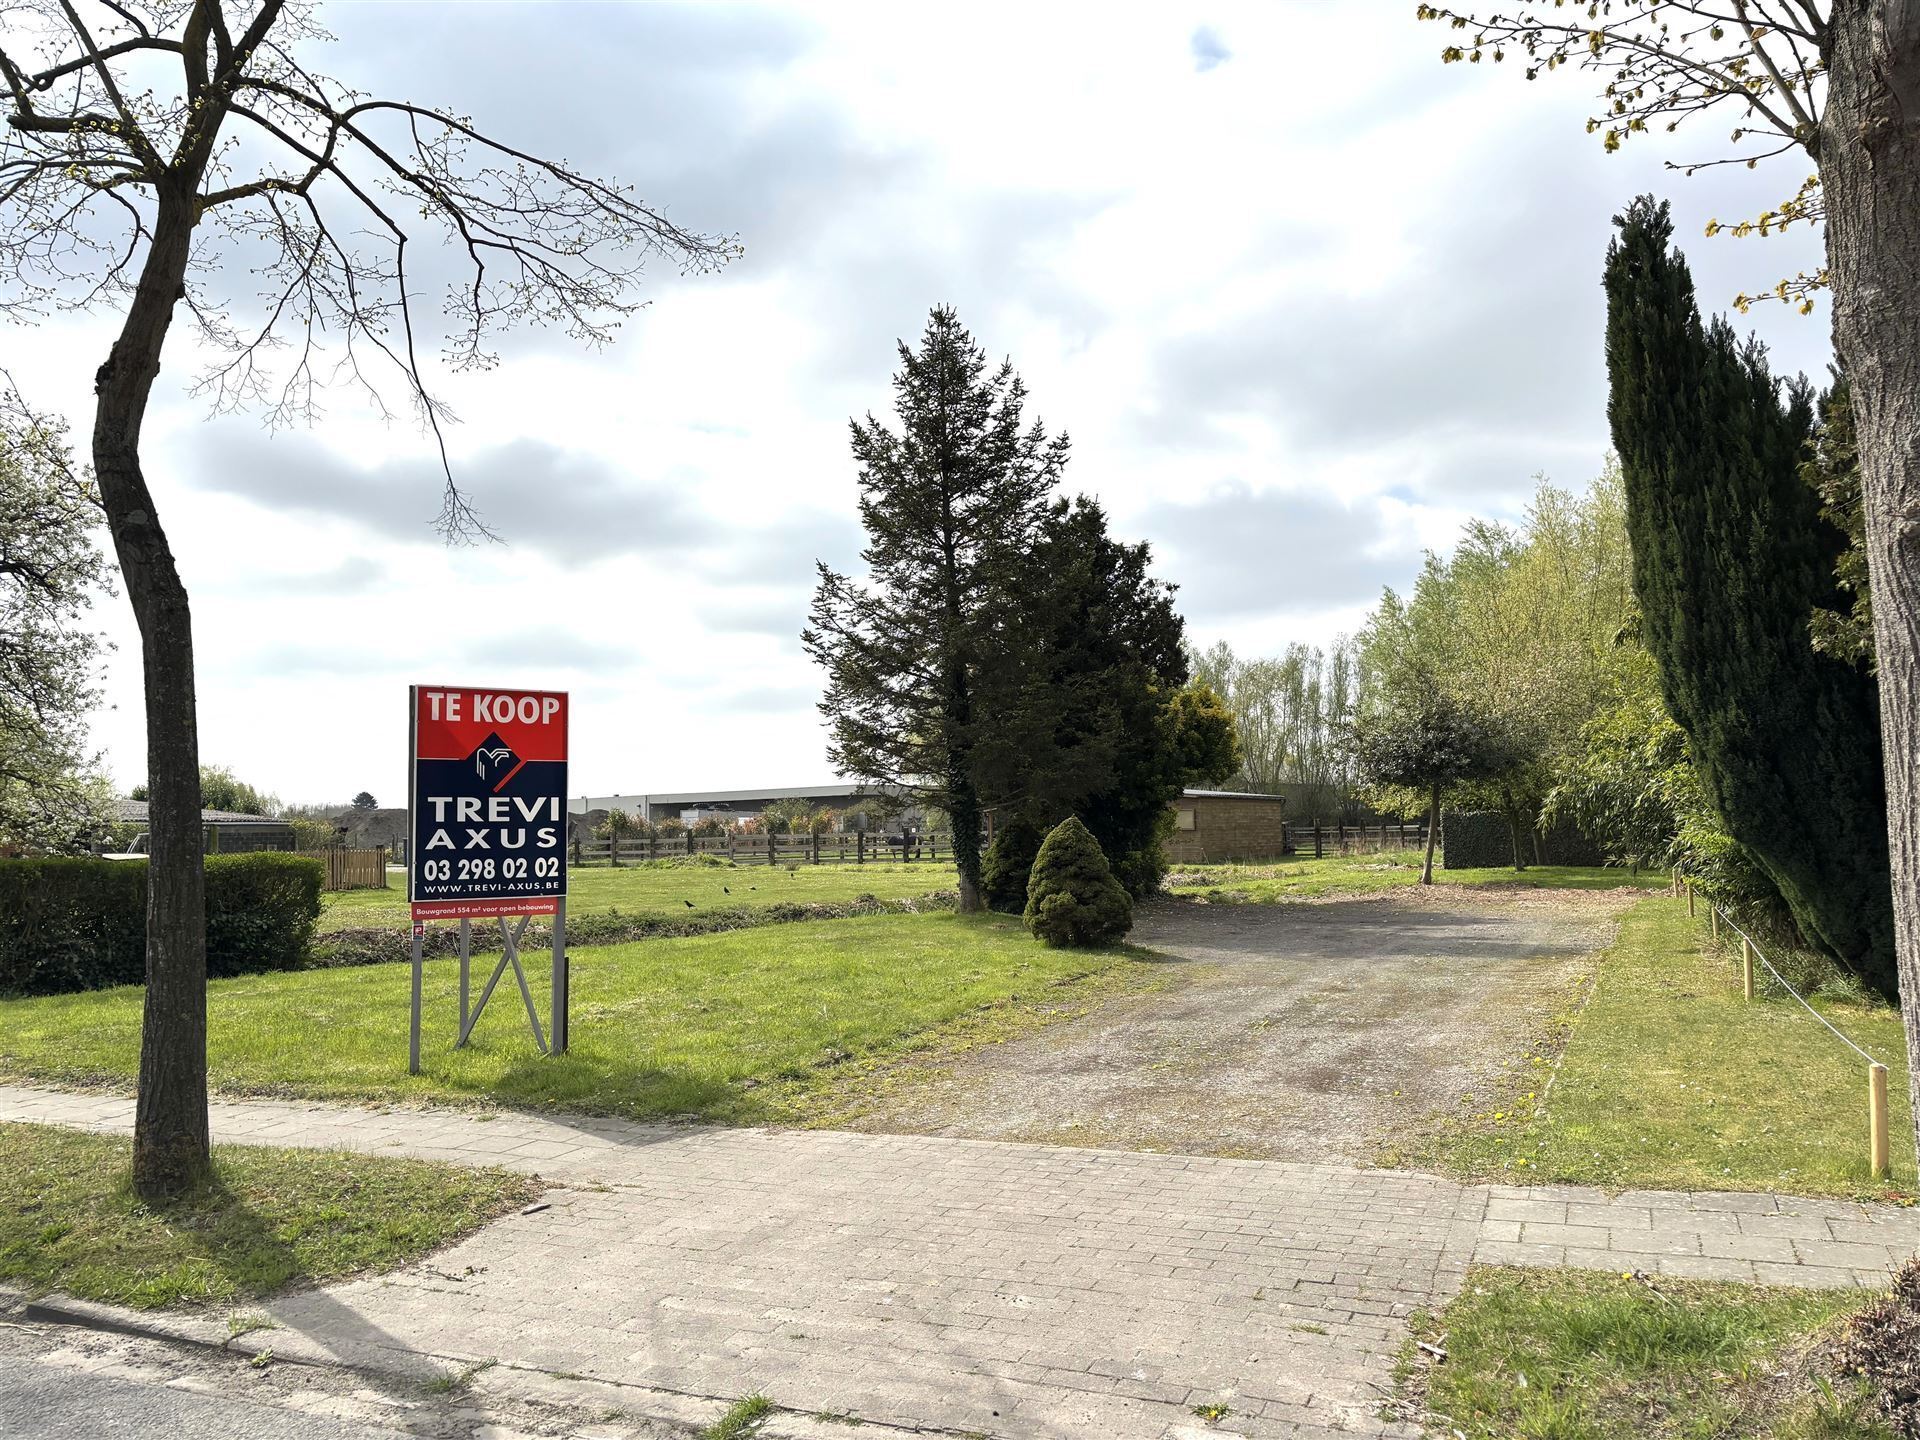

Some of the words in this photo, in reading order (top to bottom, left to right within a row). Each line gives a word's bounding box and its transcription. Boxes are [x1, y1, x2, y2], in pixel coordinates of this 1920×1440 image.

[427, 692, 461, 722] TE
[473, 695, 560, 724] KOOP
[427, 796, 560, 823] TREVI
[425, 827, 558, 850] AXUS
[424, 859, 451, 881] 03
[457, 858, 496, 880] 298
[502, 857, 528, 879] 02
[534, 856, 559, 878] 02
[424, 882, 559, 893] WWW.TREVI-AXUS.BE
[499, 905, 517, 913] open
